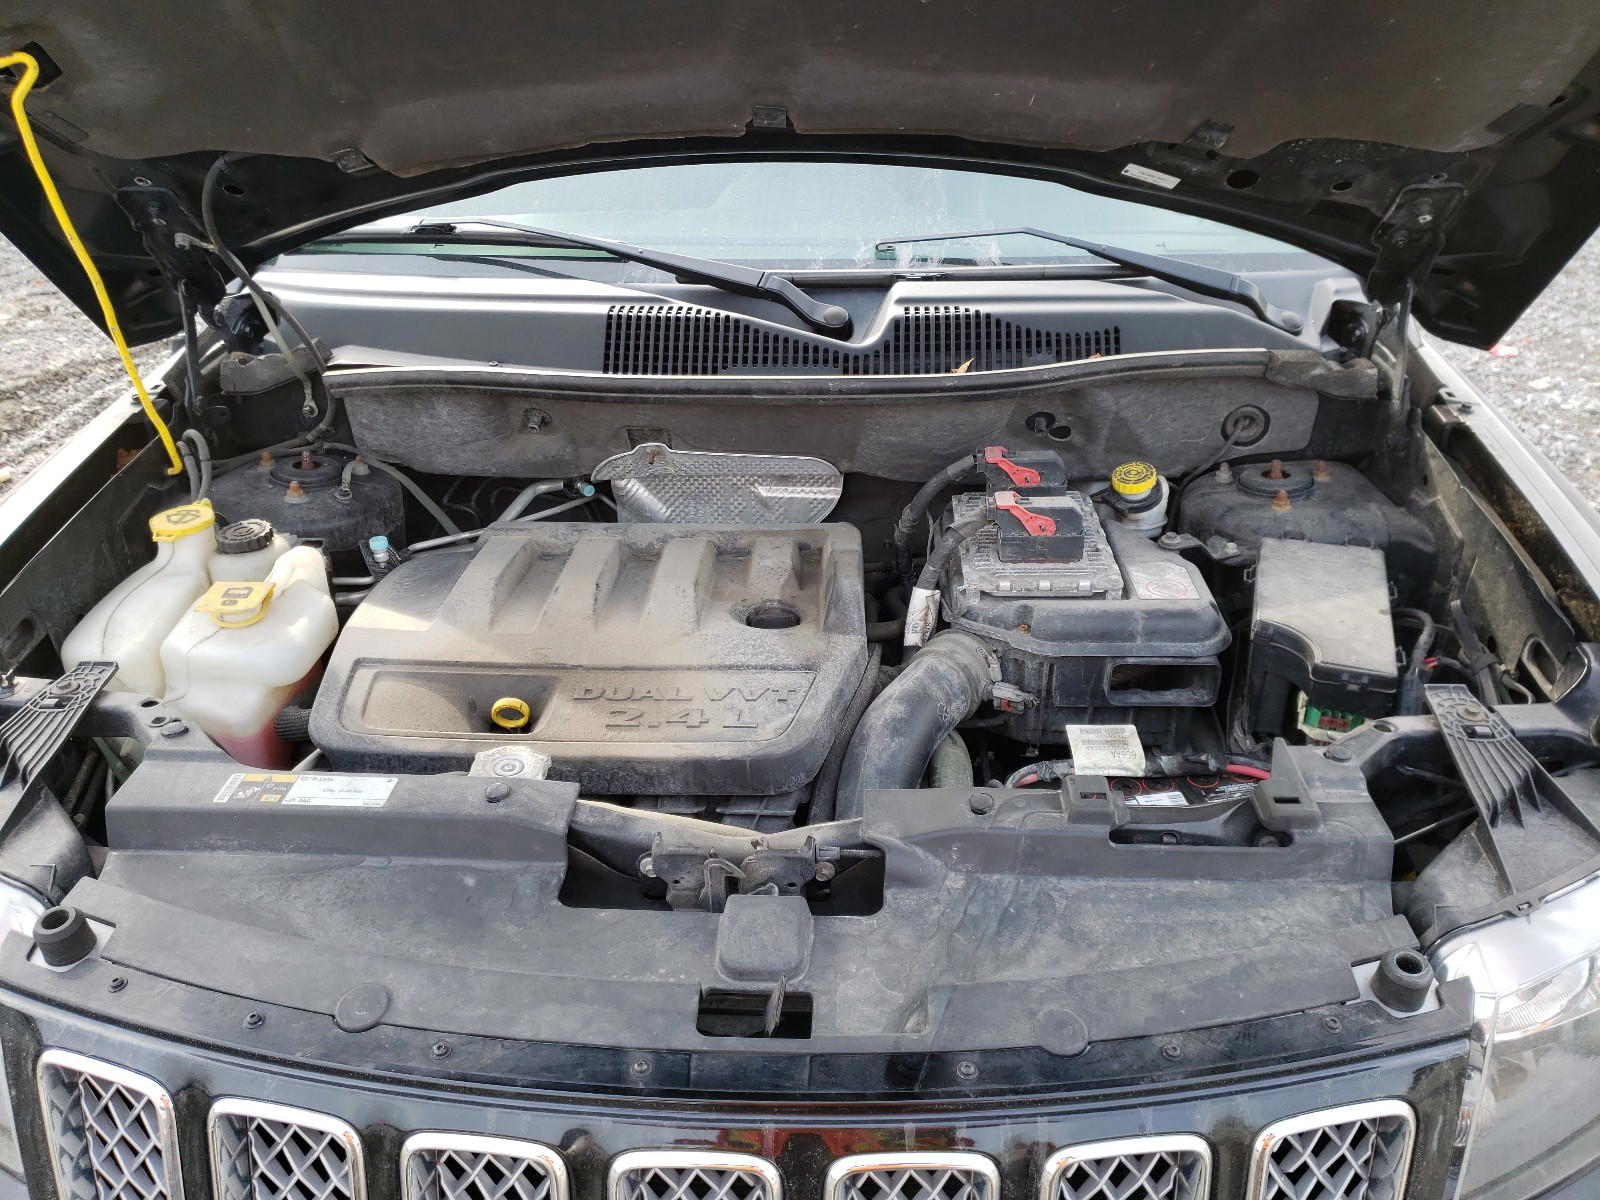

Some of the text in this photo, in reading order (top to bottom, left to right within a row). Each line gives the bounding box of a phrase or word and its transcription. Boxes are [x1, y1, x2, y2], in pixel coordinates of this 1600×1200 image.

[572, 686, 798, 703] DUAL VVT
[604, 707, 759, 730] 2.4 L
